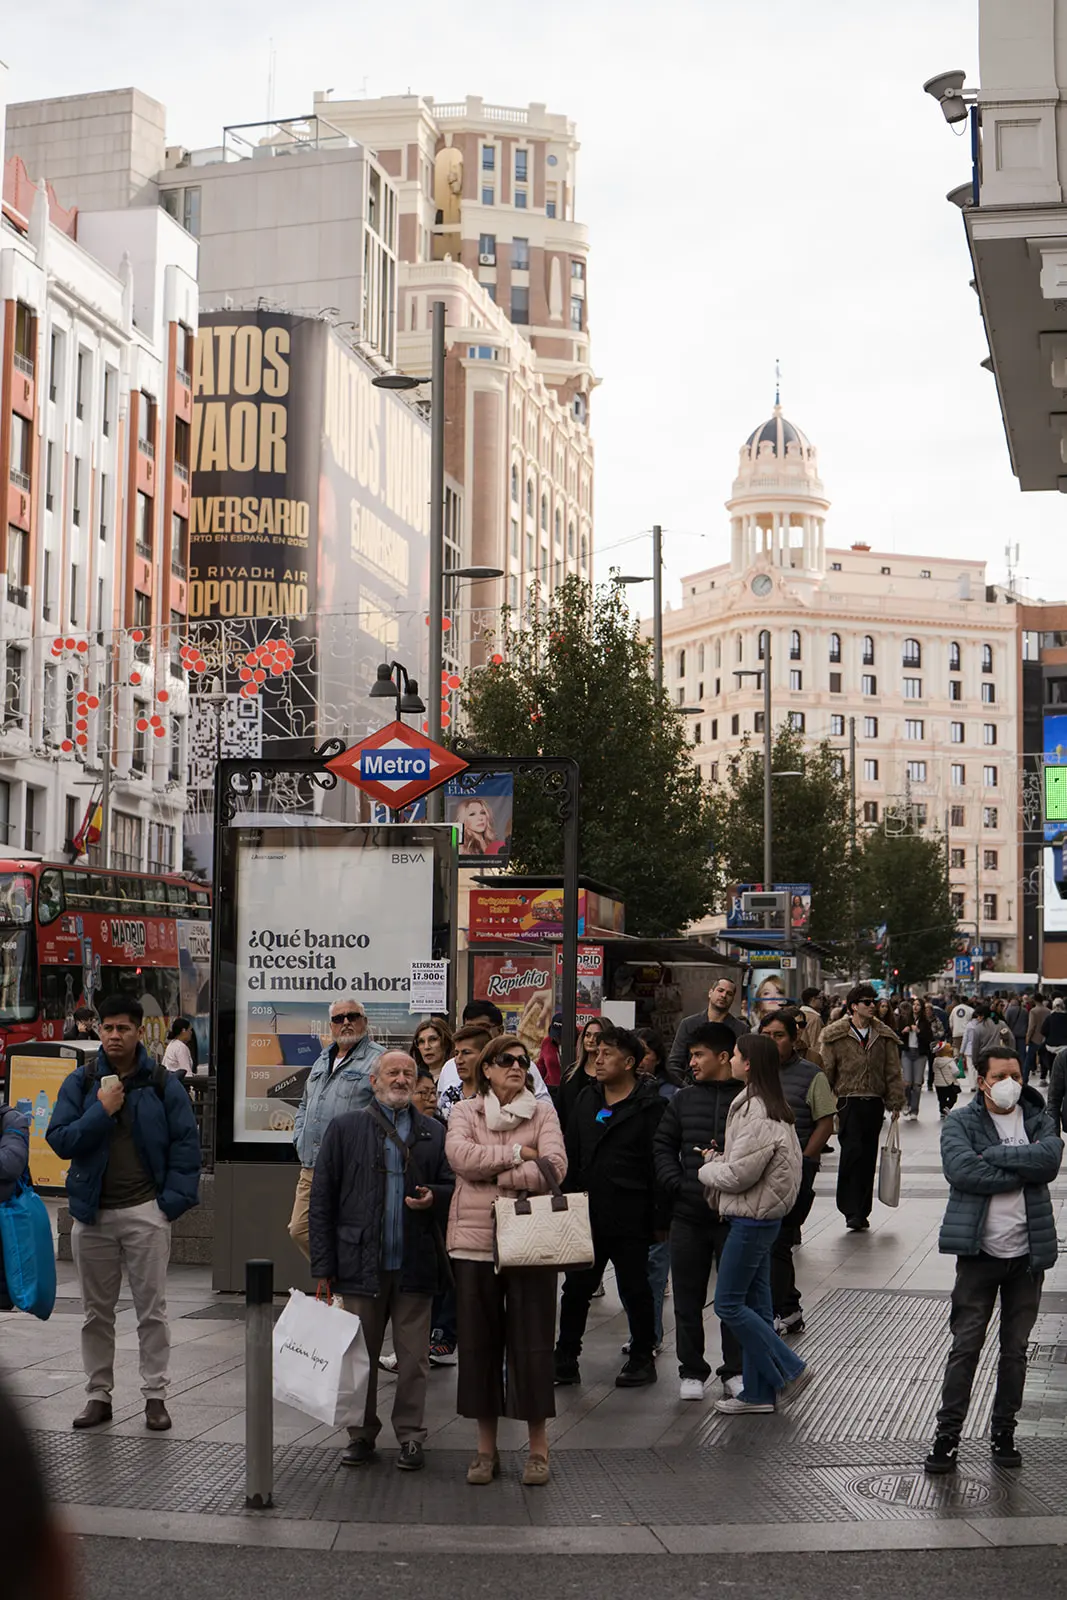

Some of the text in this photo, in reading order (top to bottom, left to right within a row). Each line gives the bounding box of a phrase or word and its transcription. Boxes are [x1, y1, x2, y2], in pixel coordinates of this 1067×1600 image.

[215, 534, 228, 543] EN
[230, 534, 270, 544] ESPAÑA
[272, 536, 286, 545] EN
[287, 537, 309, 549] 2025
[208, 566, 275, 578] RIYADH
[283, 570, 309, 582] AIR
[365, 756, 426, 774] Metro
[391, 853, 426, 864] BBVA
[110, 919, 147, 948] MADRID
[248, 929, 370, 951] ¿Qué banco
[248, 951, 336, 969] necesita
[248, 971, 410, 991] el mundo ahora
[488, 968, 550, 996] Rapiditas
[251, 1006, 273, 1015] 2018
[251, 1039, 271, 1048] 2017
[251, 1071, 270, 1080] 1995
